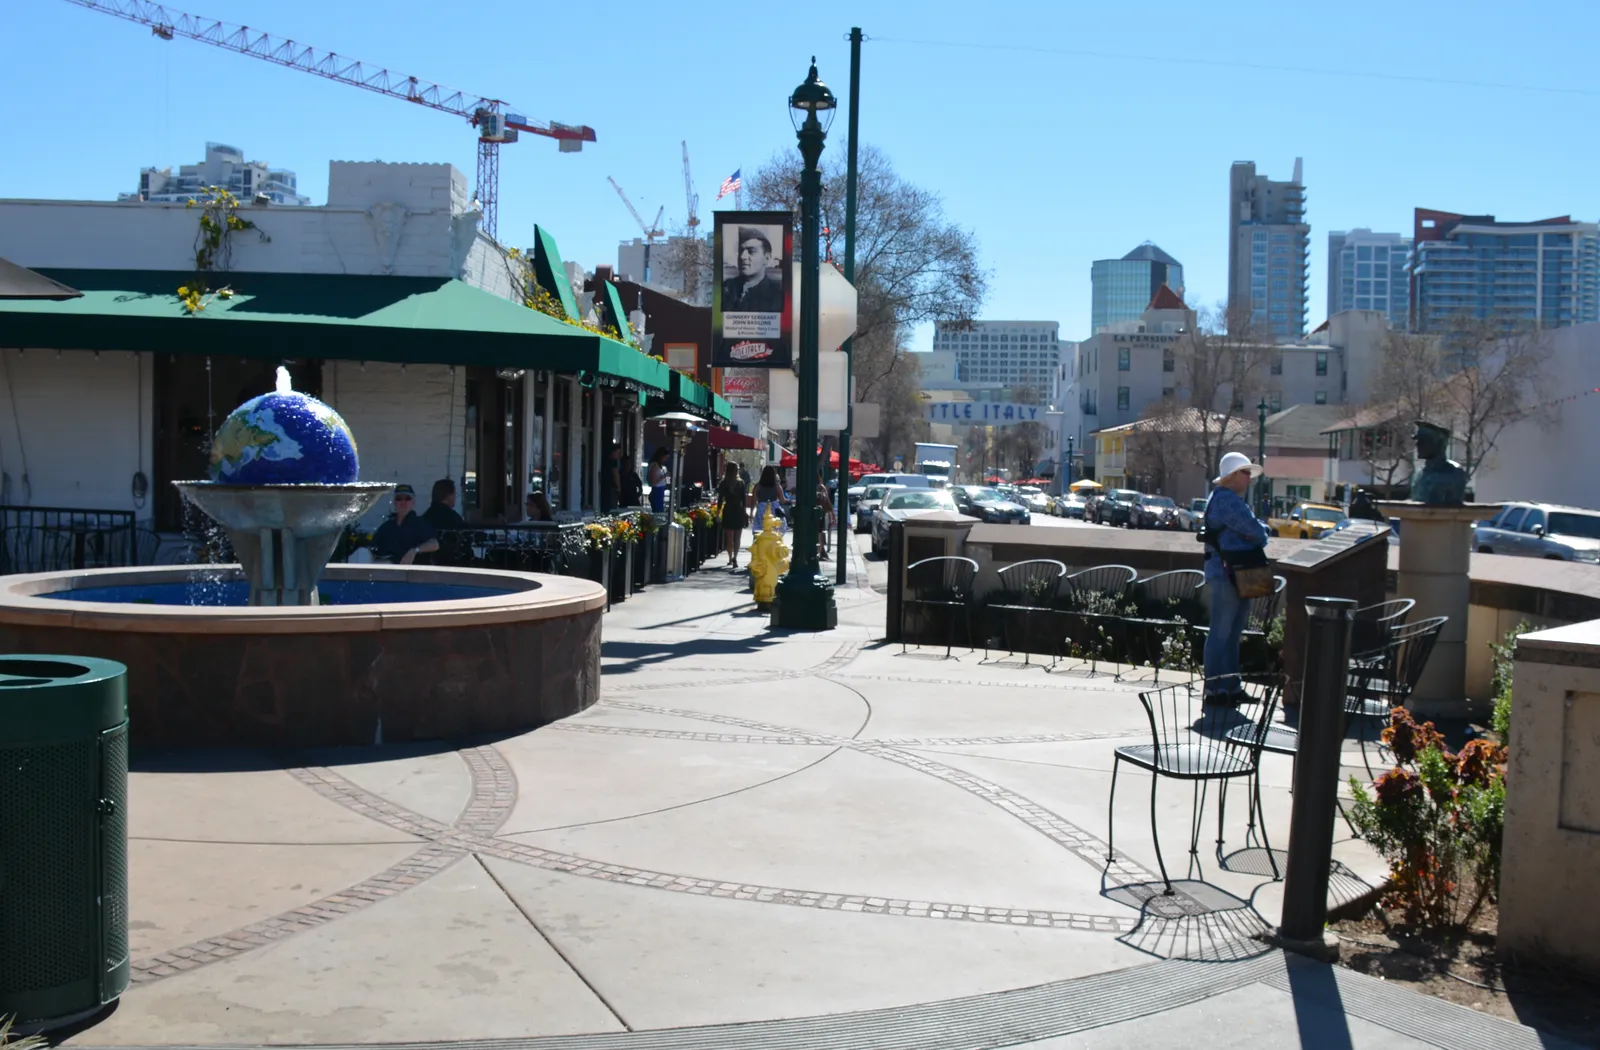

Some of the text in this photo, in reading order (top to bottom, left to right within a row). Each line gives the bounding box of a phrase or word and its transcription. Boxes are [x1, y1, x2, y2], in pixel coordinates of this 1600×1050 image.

[745, 344, 762, 354] ITALY
[930, 404, 1037, 420] TTLE ITALY
